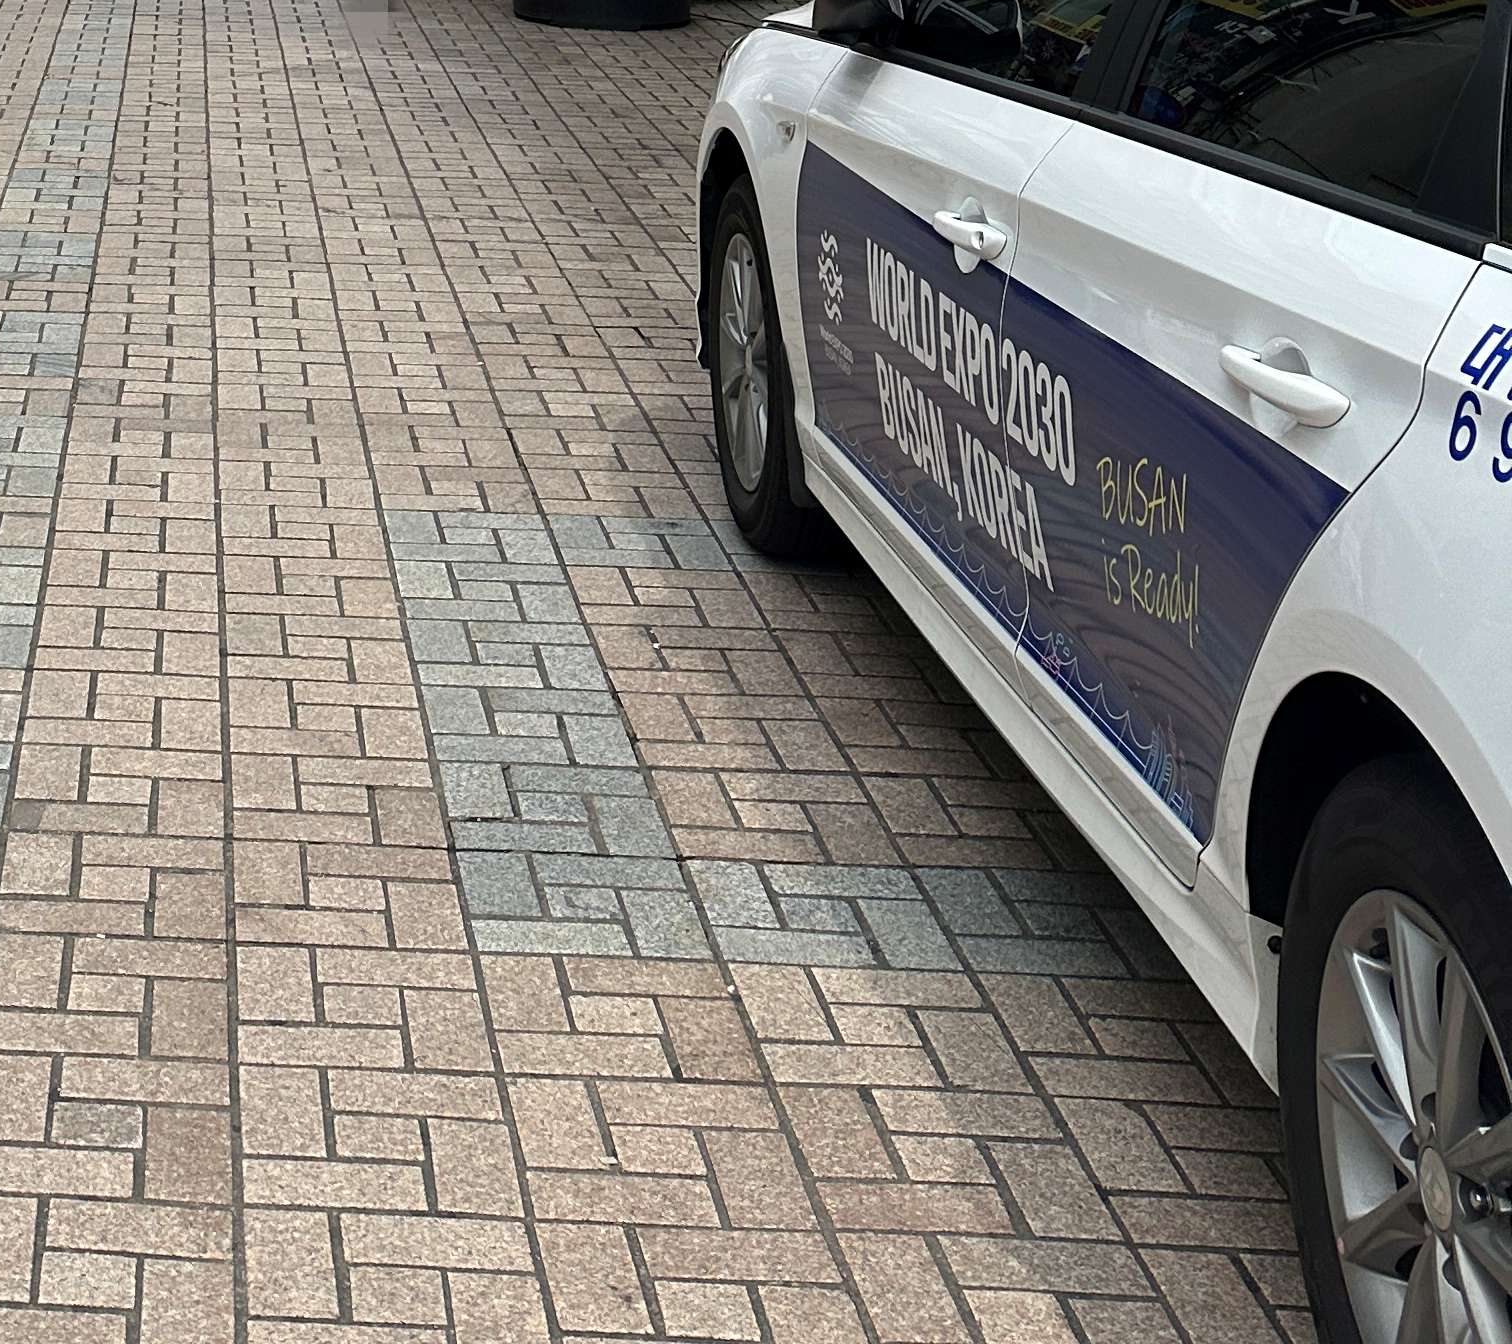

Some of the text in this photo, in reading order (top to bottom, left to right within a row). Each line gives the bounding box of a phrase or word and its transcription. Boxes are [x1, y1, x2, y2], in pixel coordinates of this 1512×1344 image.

[864, 237, 1077, 488] WORLD EXPO 2030
[955, 420, 1056, 594] KOREA
[1096, 454, 1188, 535] BUSAN
[1103, 537, 1201, 651] is Ready!
